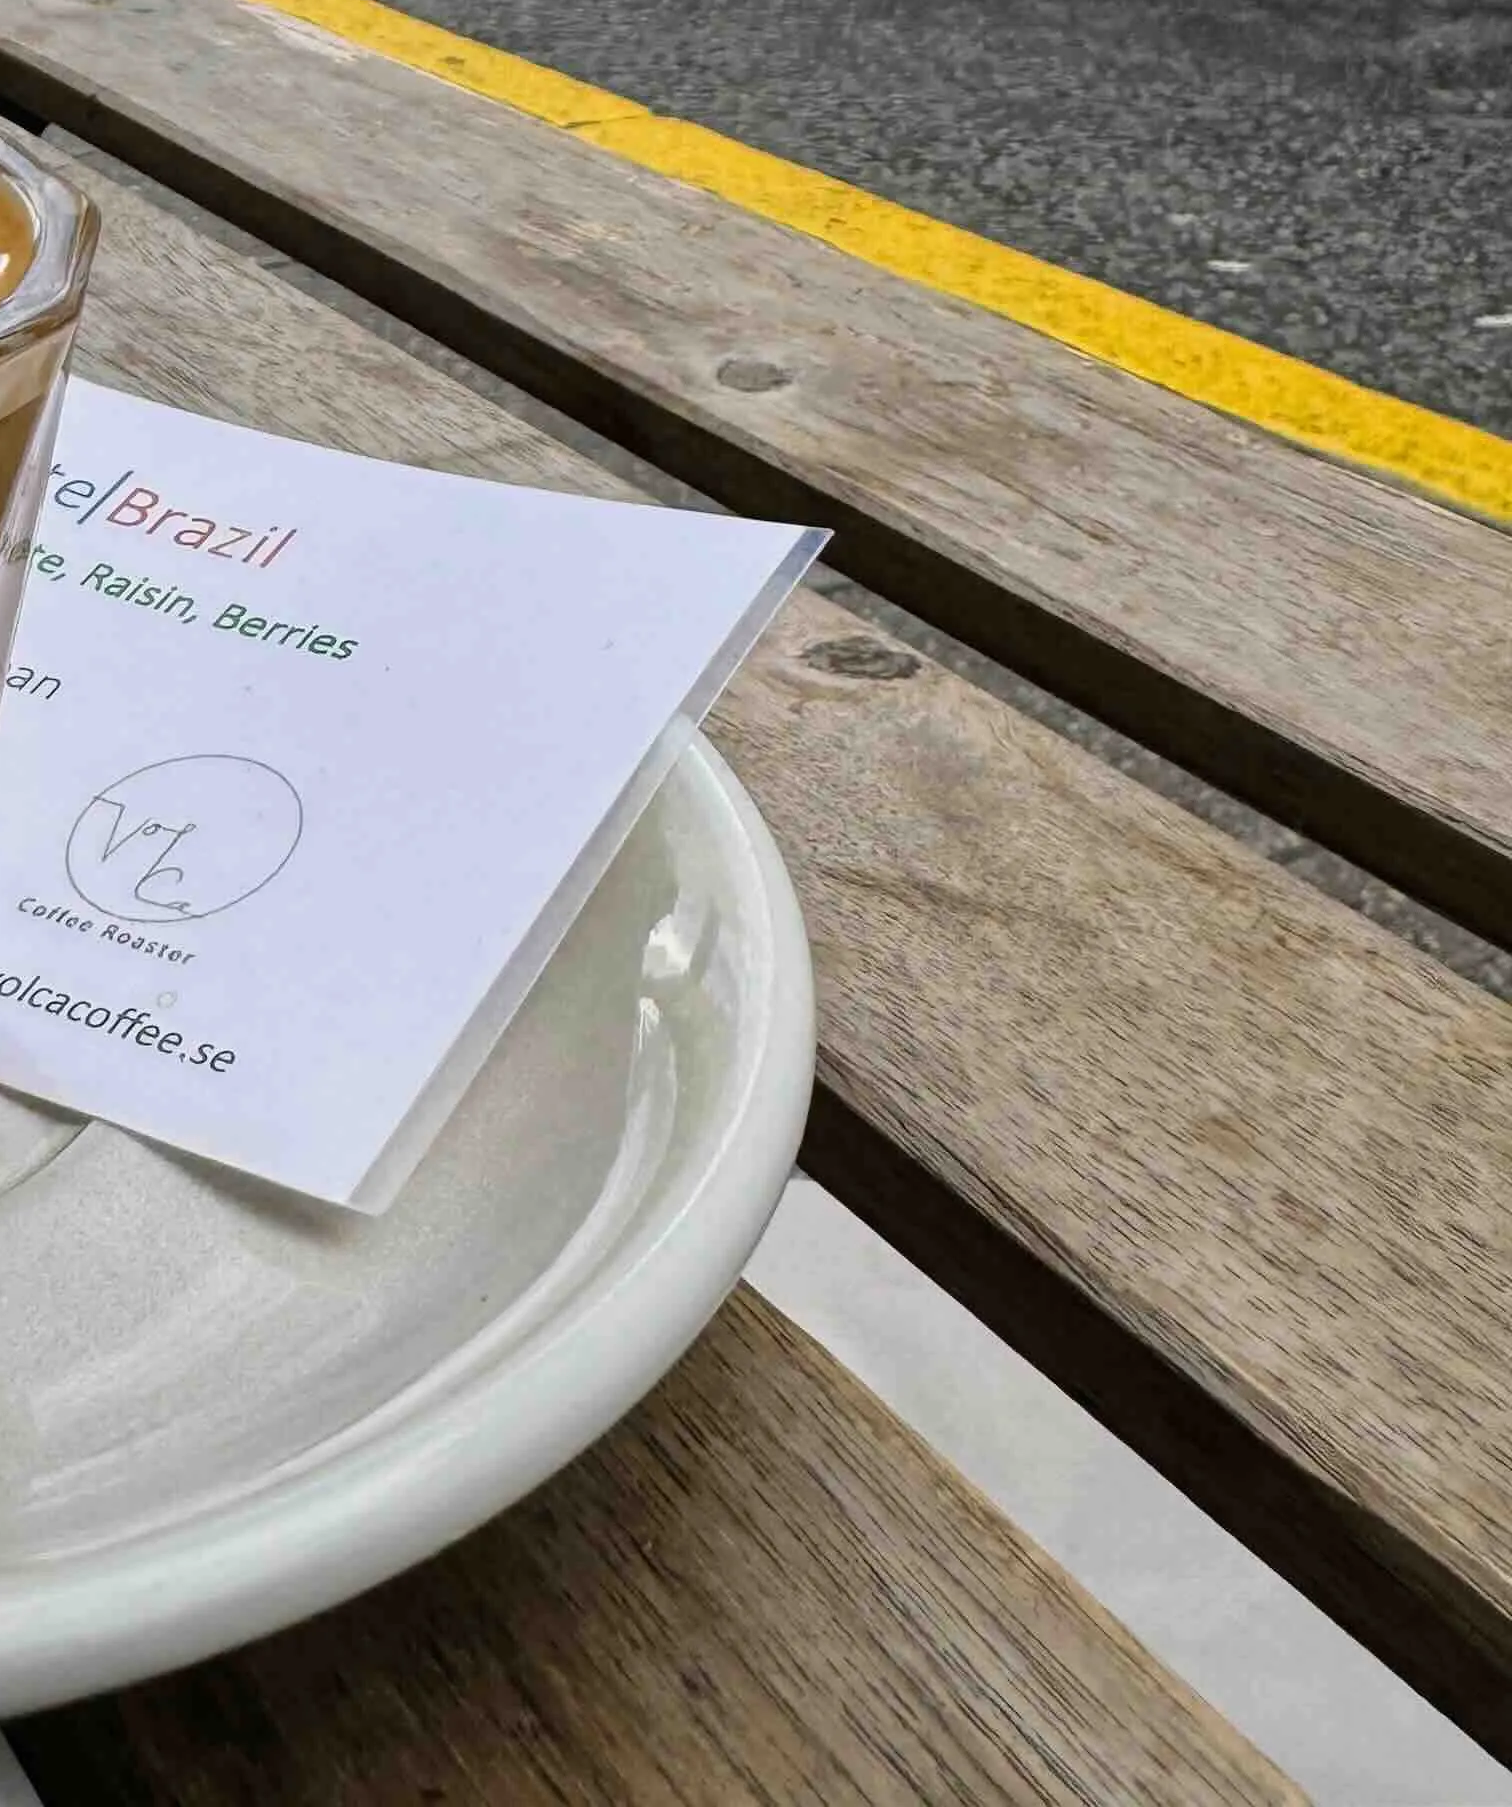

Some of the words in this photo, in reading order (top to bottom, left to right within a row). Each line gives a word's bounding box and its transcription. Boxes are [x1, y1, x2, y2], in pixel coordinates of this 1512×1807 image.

[80, 562, 197, 624] Raisin,
[212, 602, 360, 660] Berries
[6, 663, 62, 699] an
[17, 896, 93, 933] Coffee
[100, 923, 197, 966] Roaster
